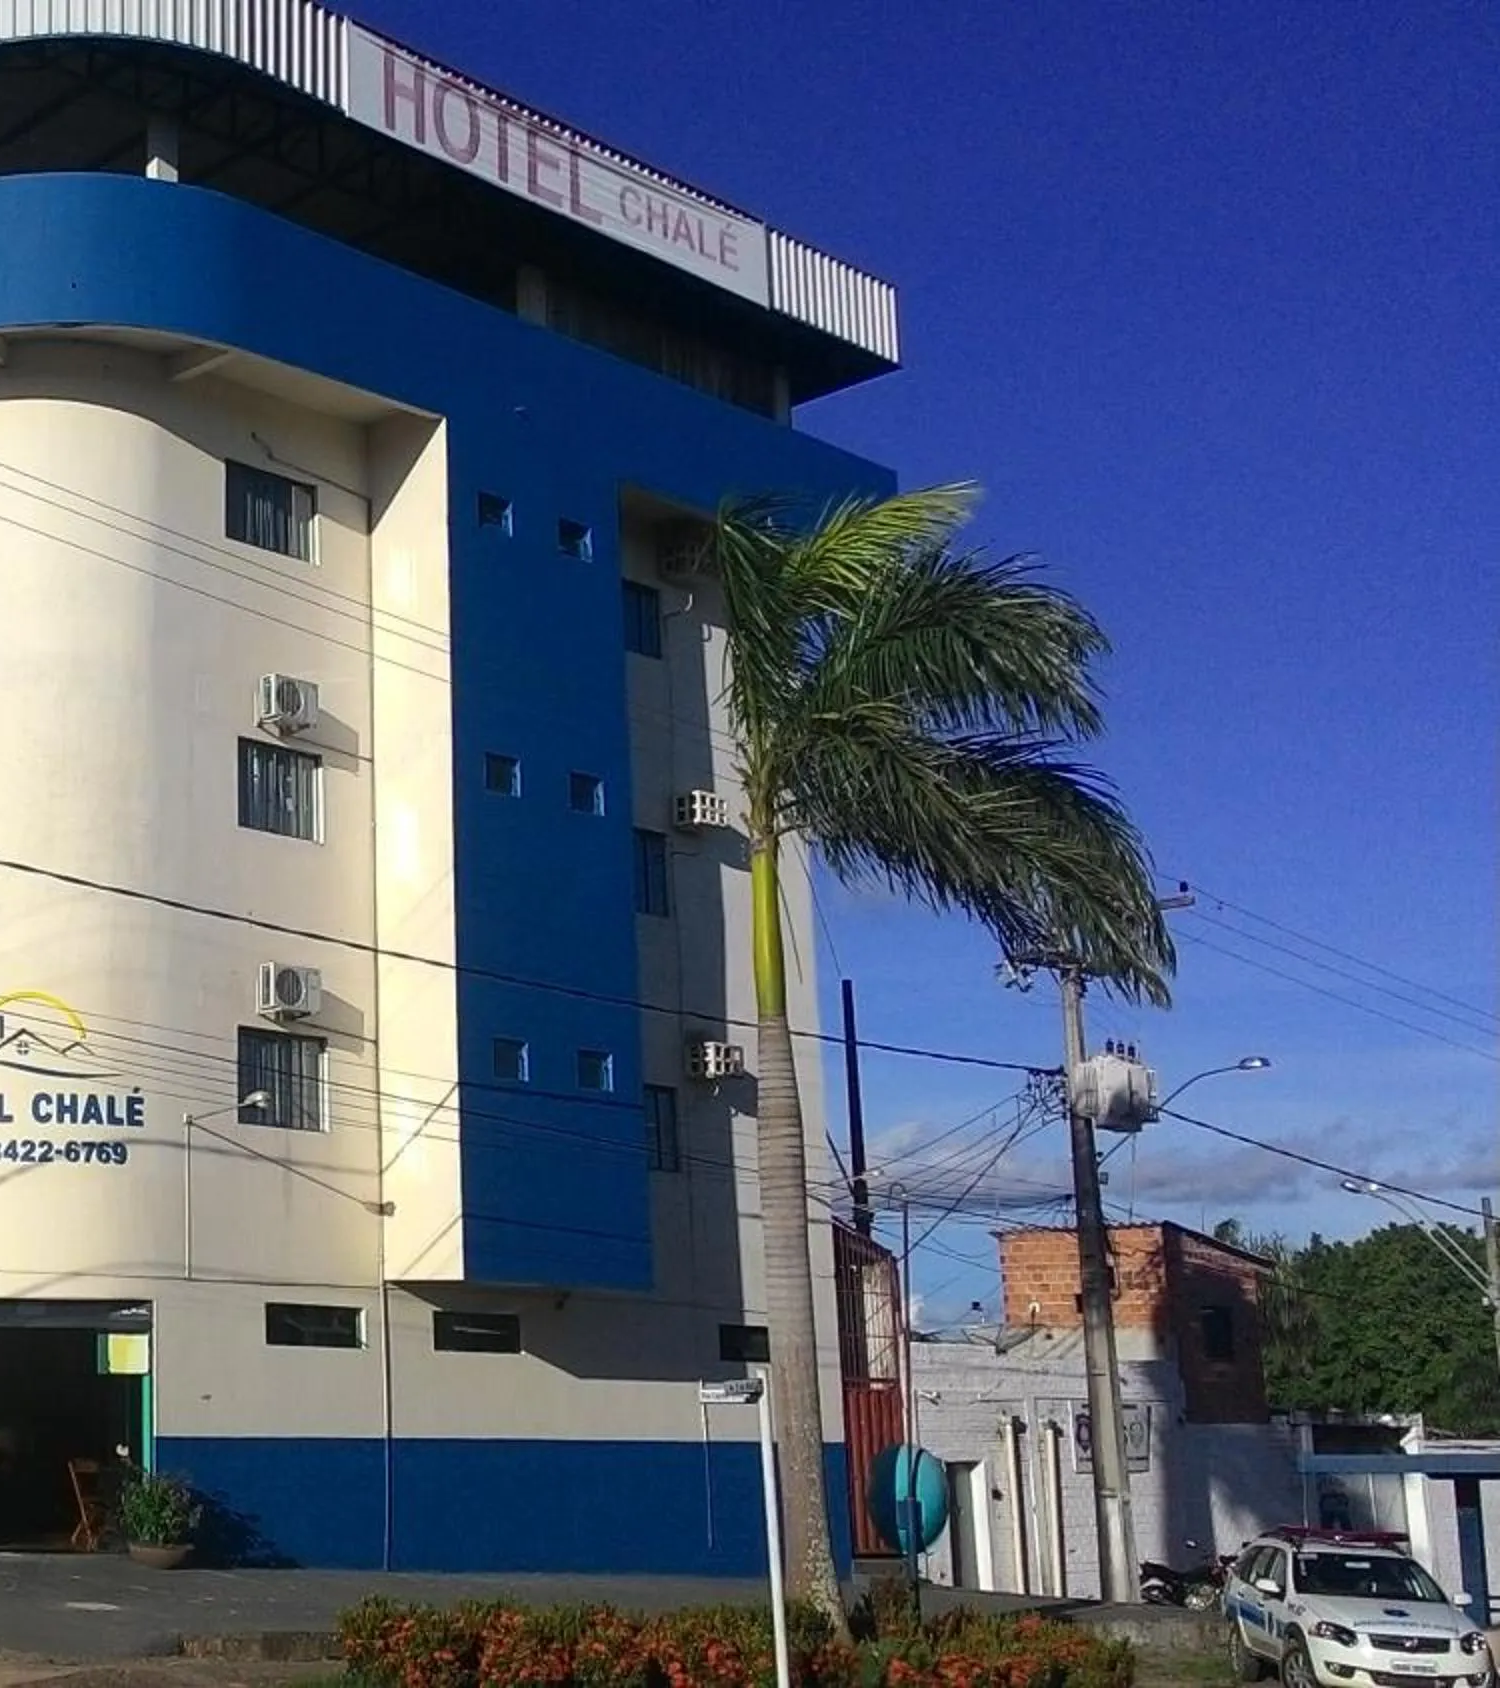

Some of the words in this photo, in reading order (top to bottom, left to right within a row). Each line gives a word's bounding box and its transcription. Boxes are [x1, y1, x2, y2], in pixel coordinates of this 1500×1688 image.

[382, 46, 604, 224] HOTEL
[619, 183, 740, 272] CHALÉ
[31, 1087, 145, 1127] CHALÉ
